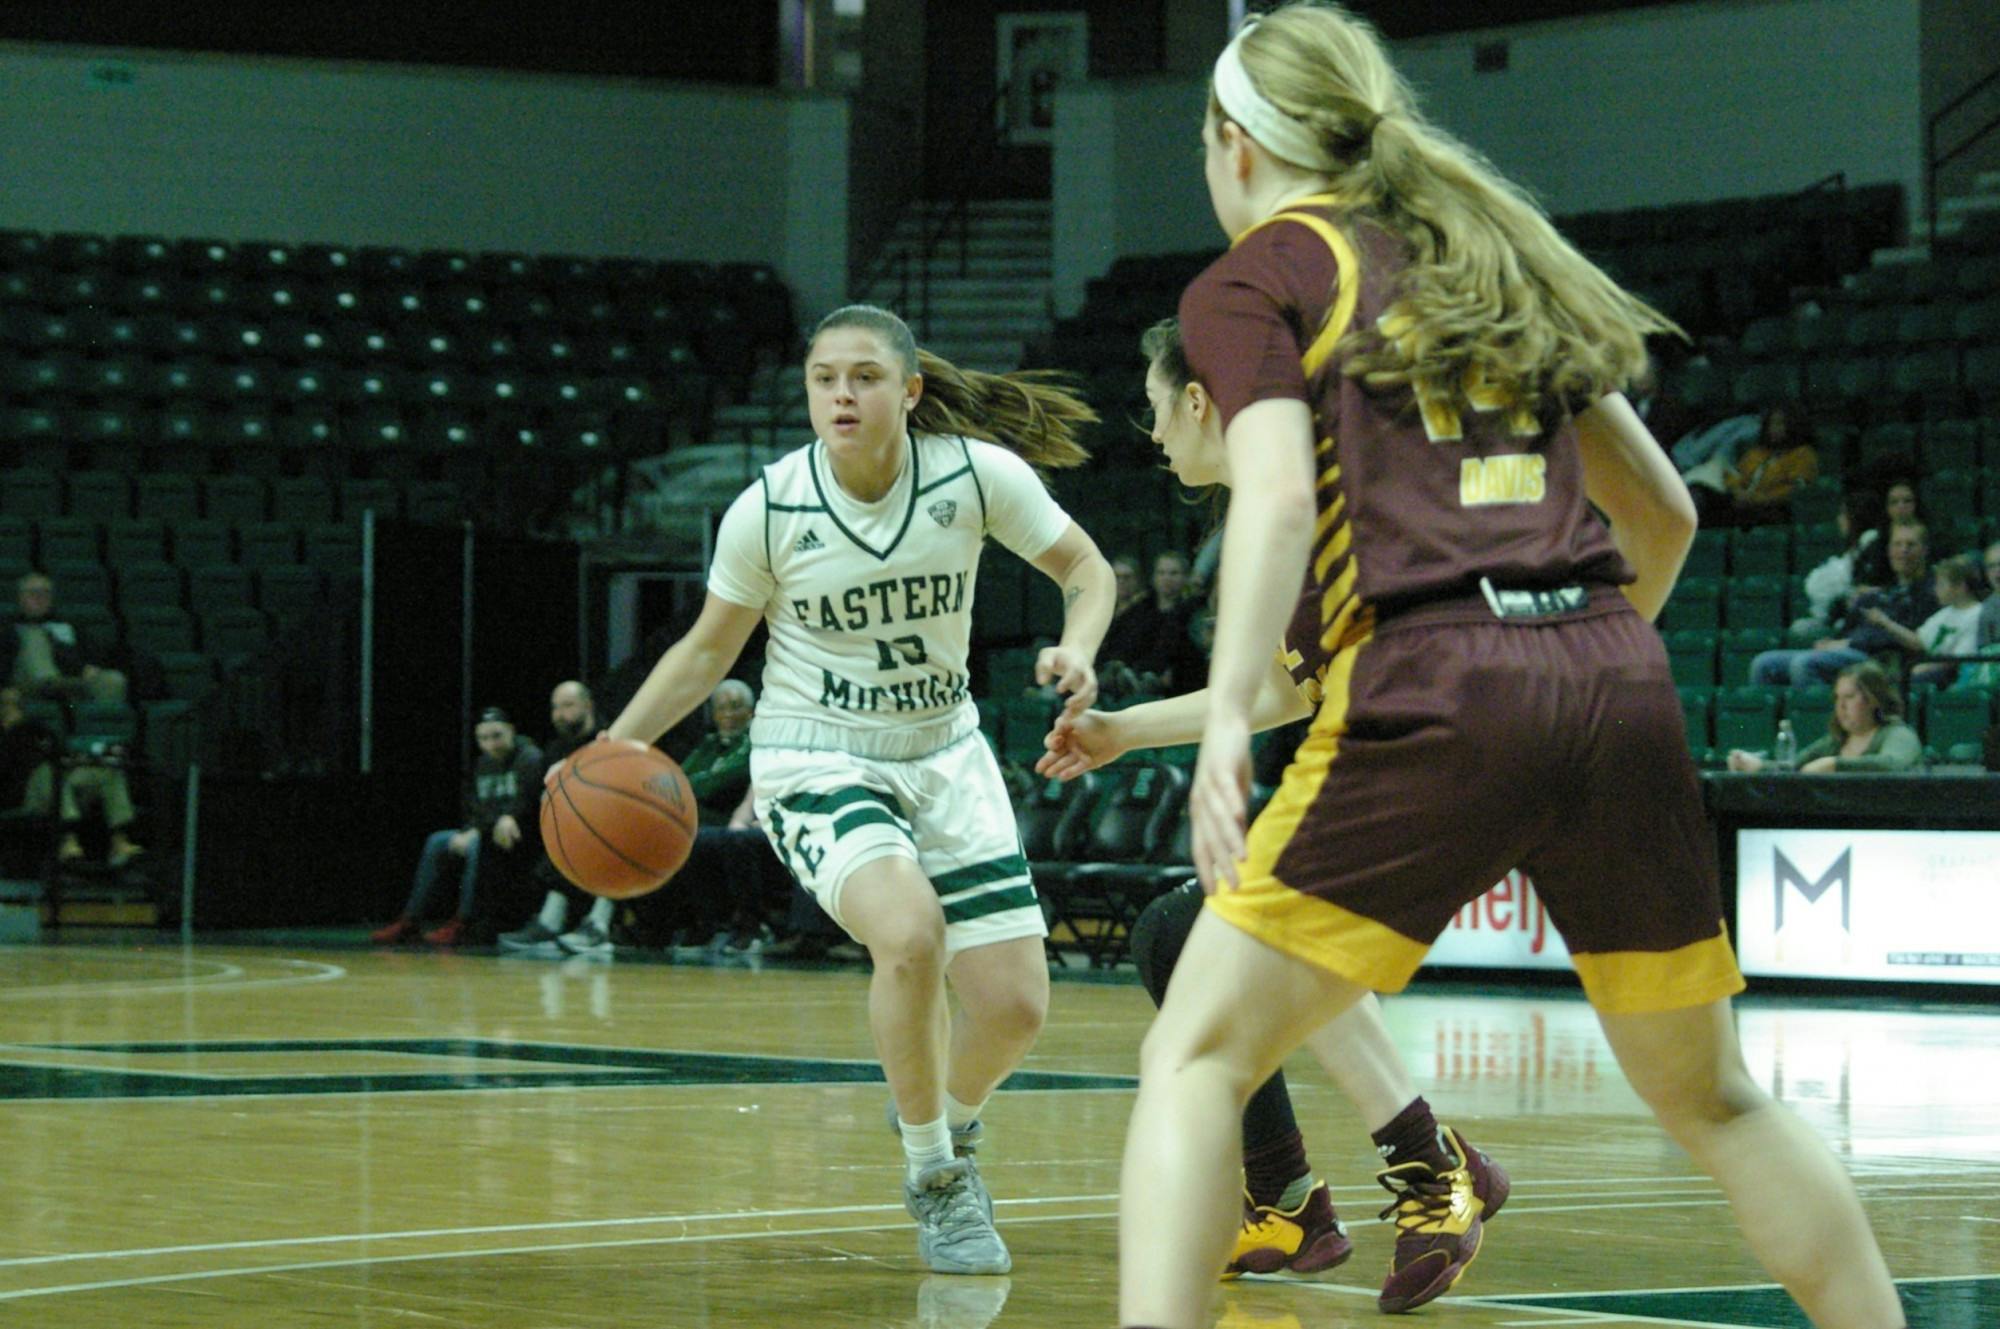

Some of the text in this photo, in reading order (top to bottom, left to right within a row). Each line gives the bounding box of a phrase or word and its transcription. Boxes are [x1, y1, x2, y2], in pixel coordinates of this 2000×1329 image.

[1459, 453, 1547, 506] DAVIS
[792, 571, 967, 632] EASTERN
[819, 668, 967, 712] MICHIGA
